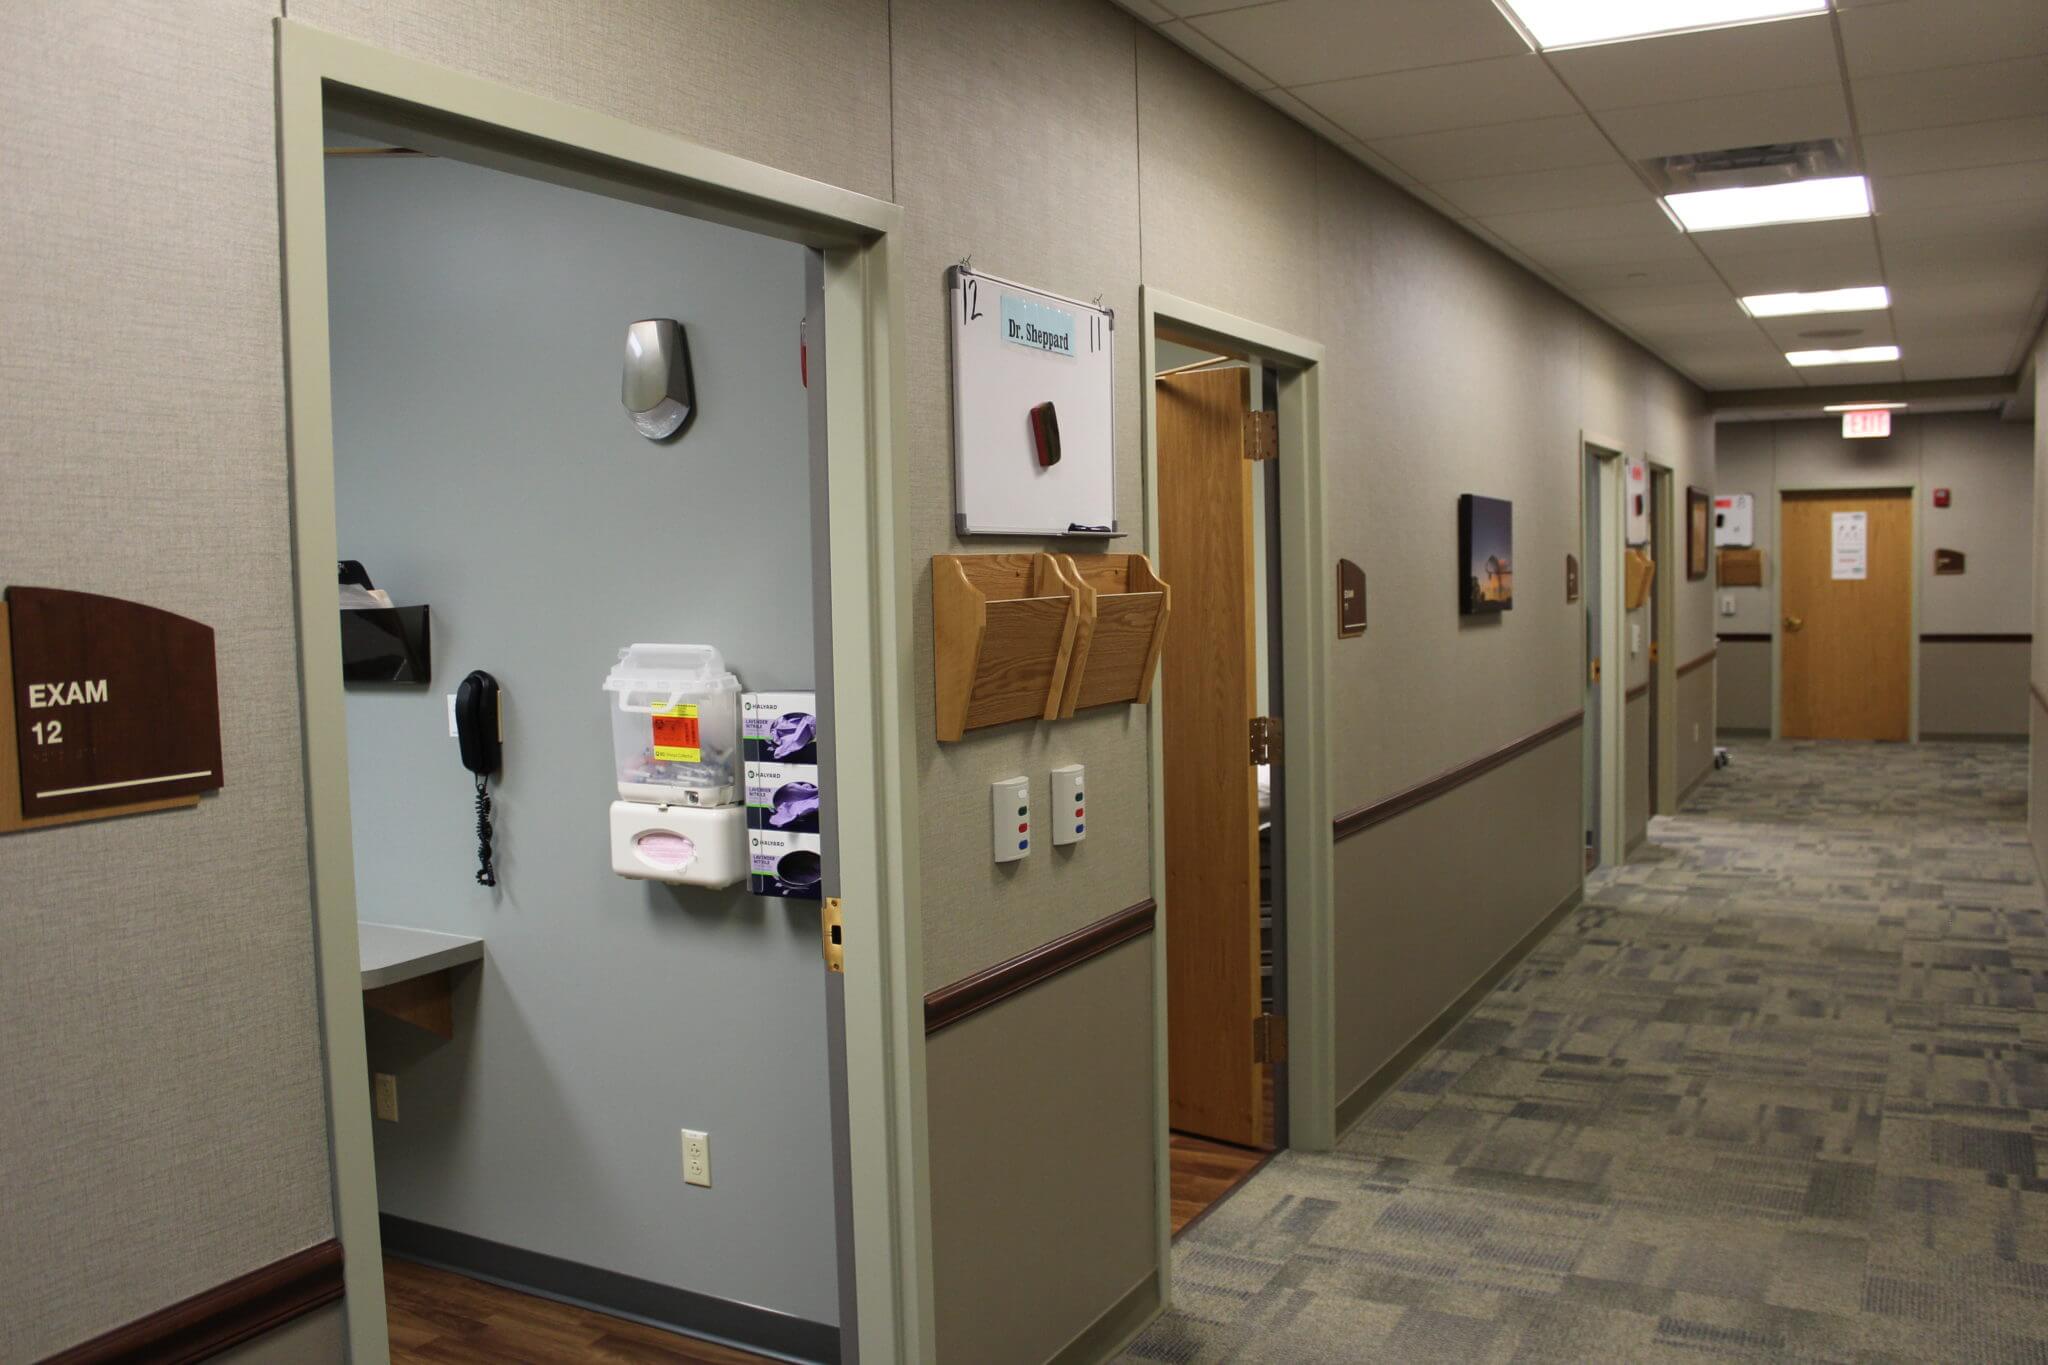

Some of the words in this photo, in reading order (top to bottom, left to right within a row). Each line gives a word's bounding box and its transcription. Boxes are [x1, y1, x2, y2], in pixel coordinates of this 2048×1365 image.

[963, 279, 983, 326] 12
[1008, 318, 1024, 340] Dr.
[1026, 322, 1069, 350] Sheppard
[1090, 315, 1101, 353] 11
[1850, 413, 1887, 433] EXIT
[29, 679, 109, 709] EXAM
[31, 720, 64, 745] 12
